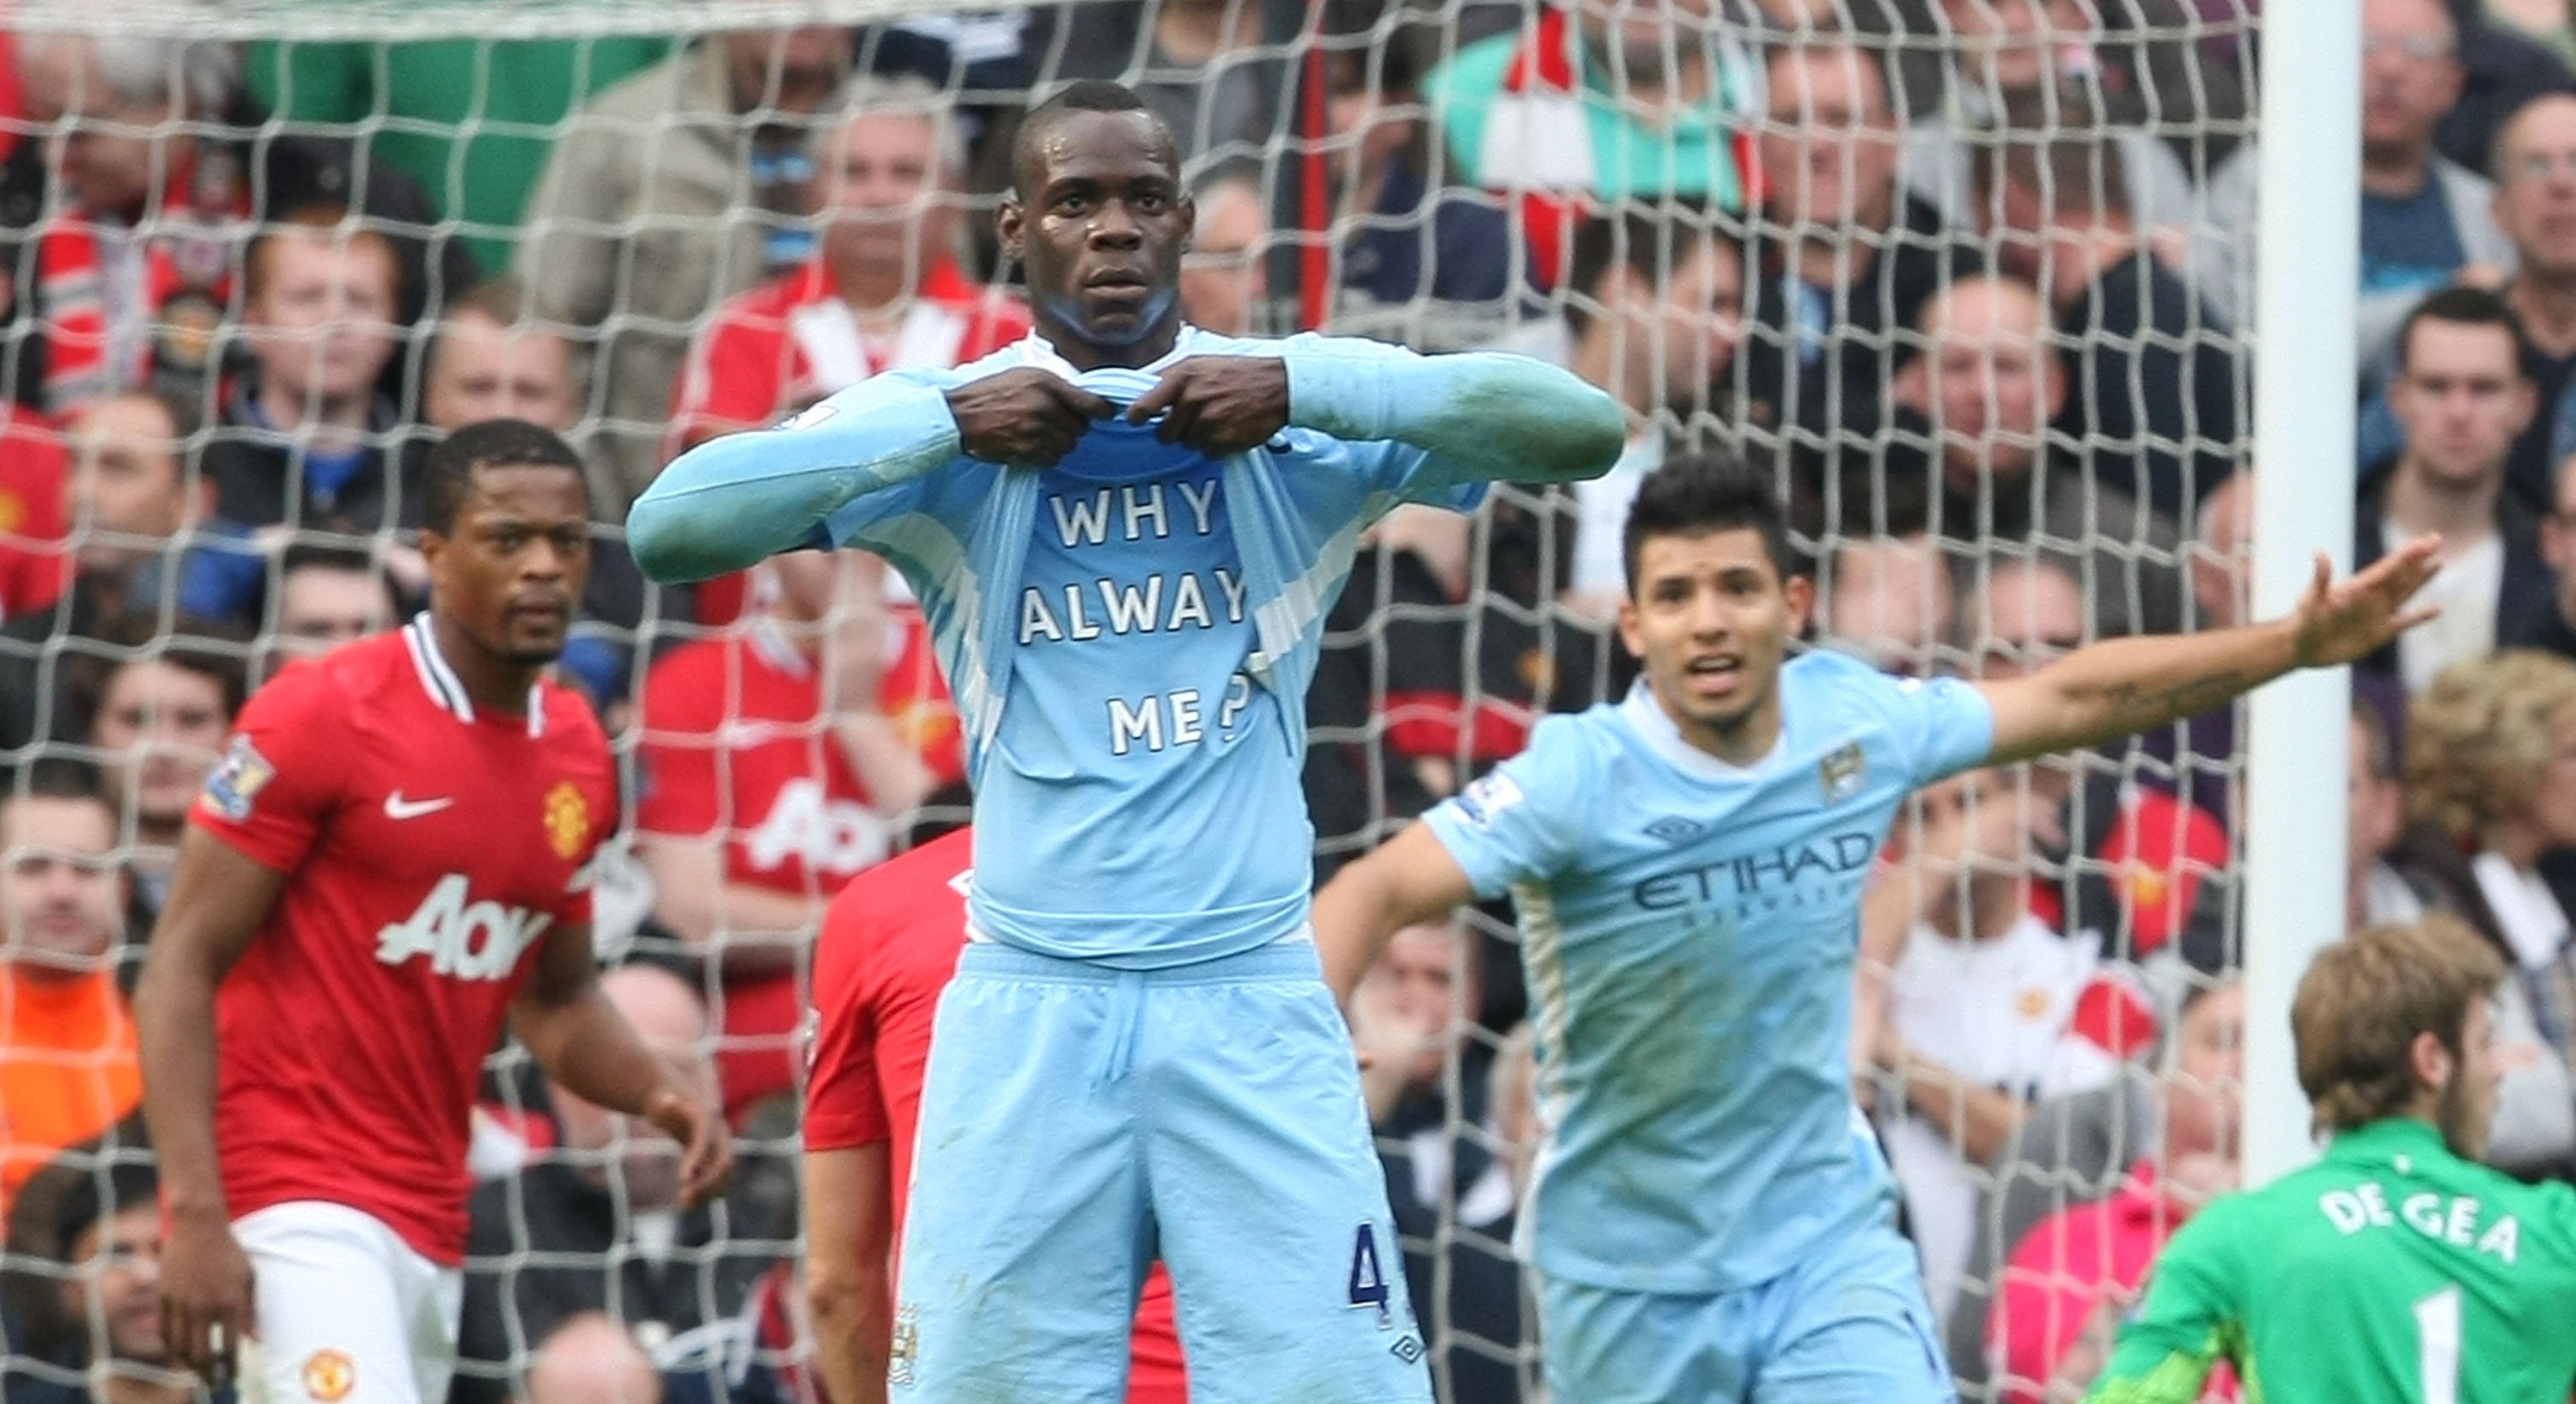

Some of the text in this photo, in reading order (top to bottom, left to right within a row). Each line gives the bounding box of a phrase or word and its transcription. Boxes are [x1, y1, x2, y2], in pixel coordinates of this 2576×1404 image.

[1049, 478, 1218, 548] WHY
[1019, 566, 1248, 646] ALWAY
[1107, 674, 1251, 755] ME?
[747, 777, 891, 877] AO
[1635, 831, 1874, 912] ETIHAD
[2318, 1182, 2520, 1266] DE GEA
[2413, 1283, 2463, 1404] 1
